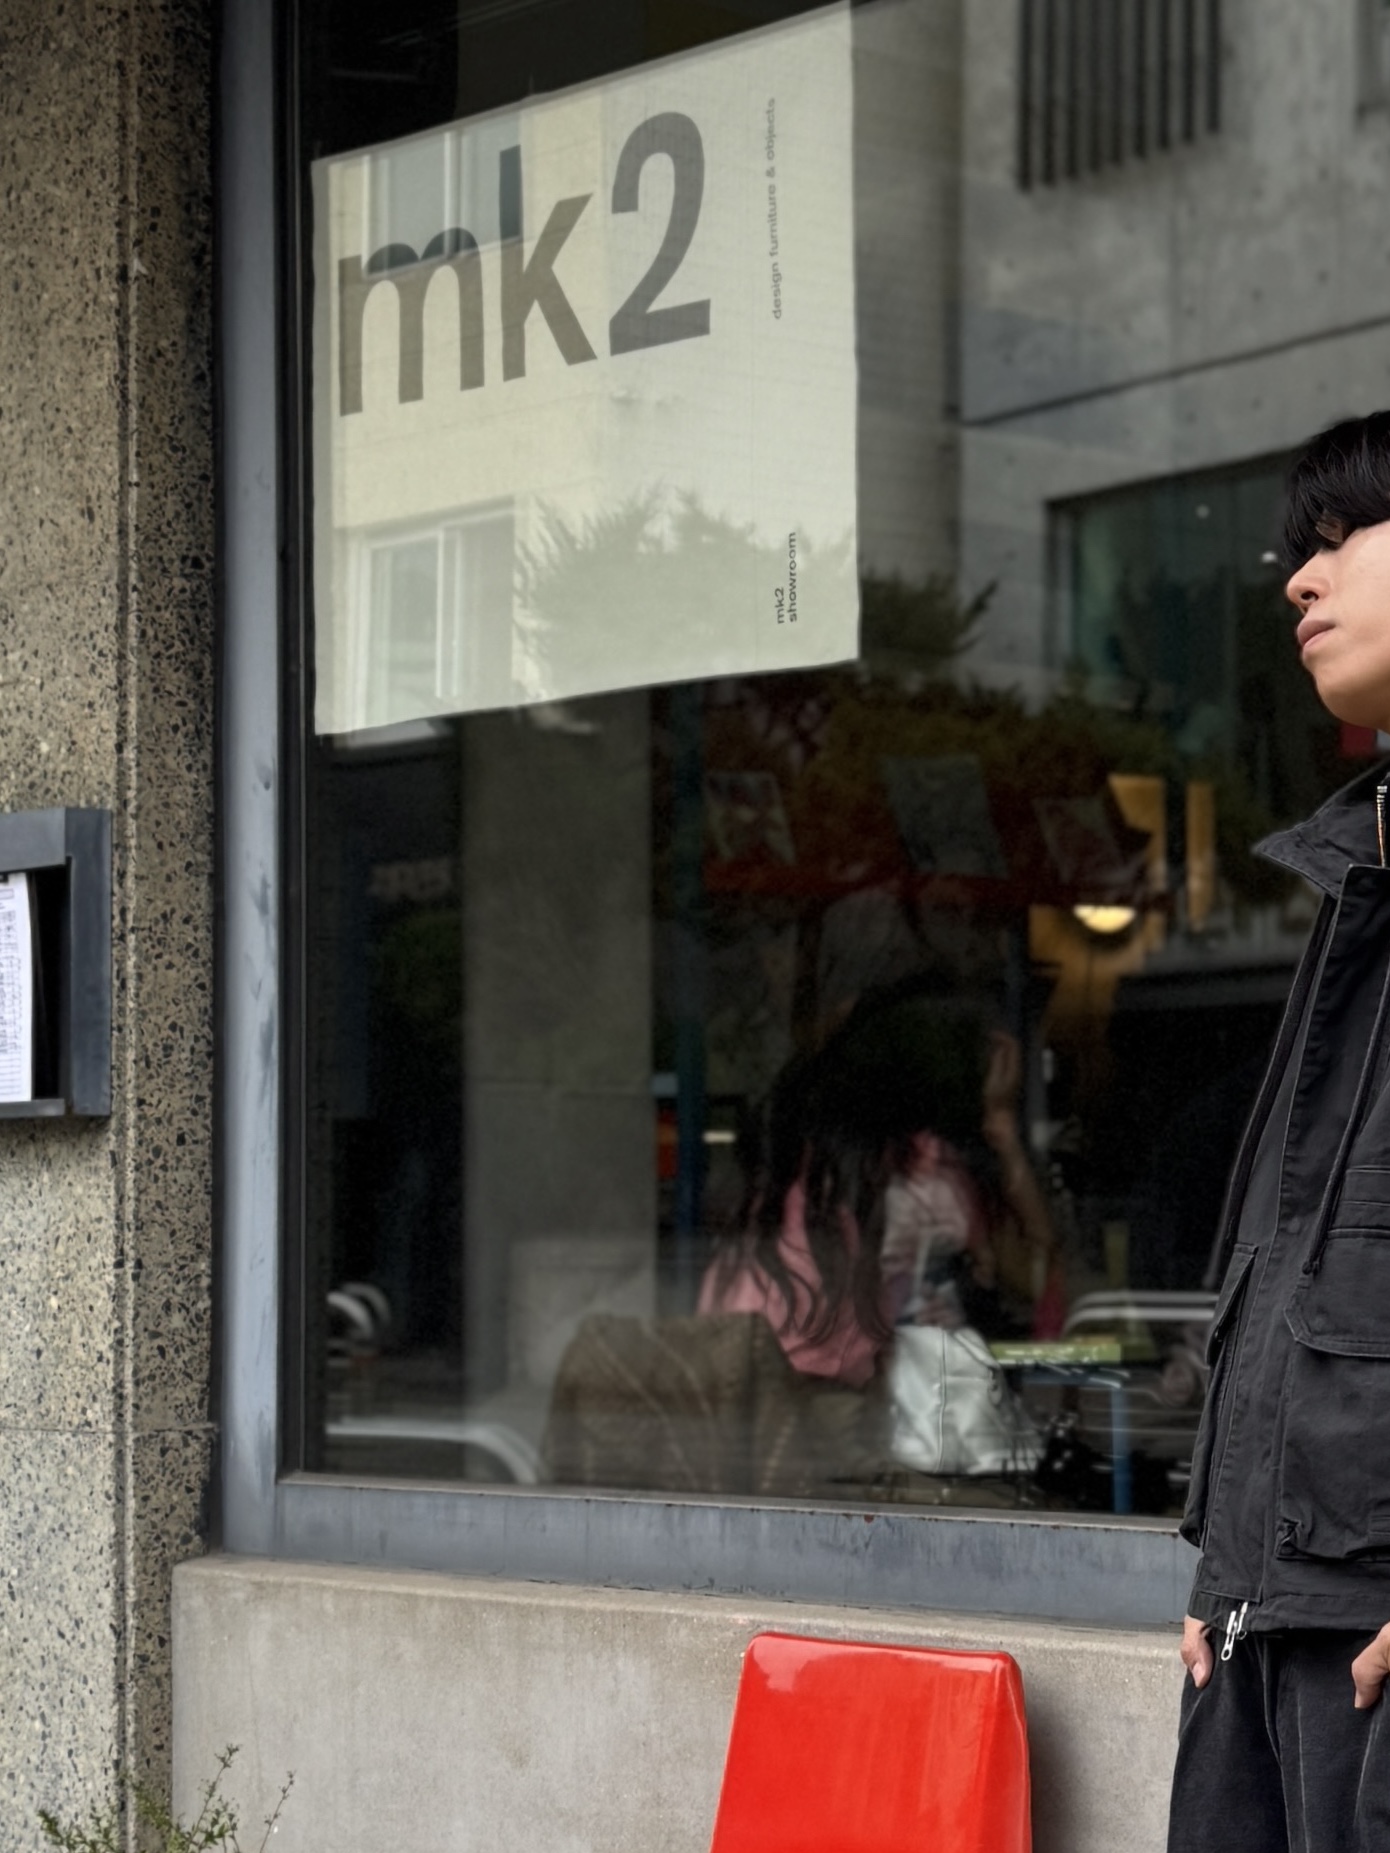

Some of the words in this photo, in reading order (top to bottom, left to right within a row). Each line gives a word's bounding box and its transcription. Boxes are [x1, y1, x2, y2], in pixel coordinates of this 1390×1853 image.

[765, 98, 776, 161] objects
[765, 165, 776, 178] &
[767, 184, 779, 257] furniture
[338, 111, 711, 417] mk2
[771, 262, 782, 320] design
[775, 587, 785, 624] mk2
[787, 532, 797, 623] showroom
